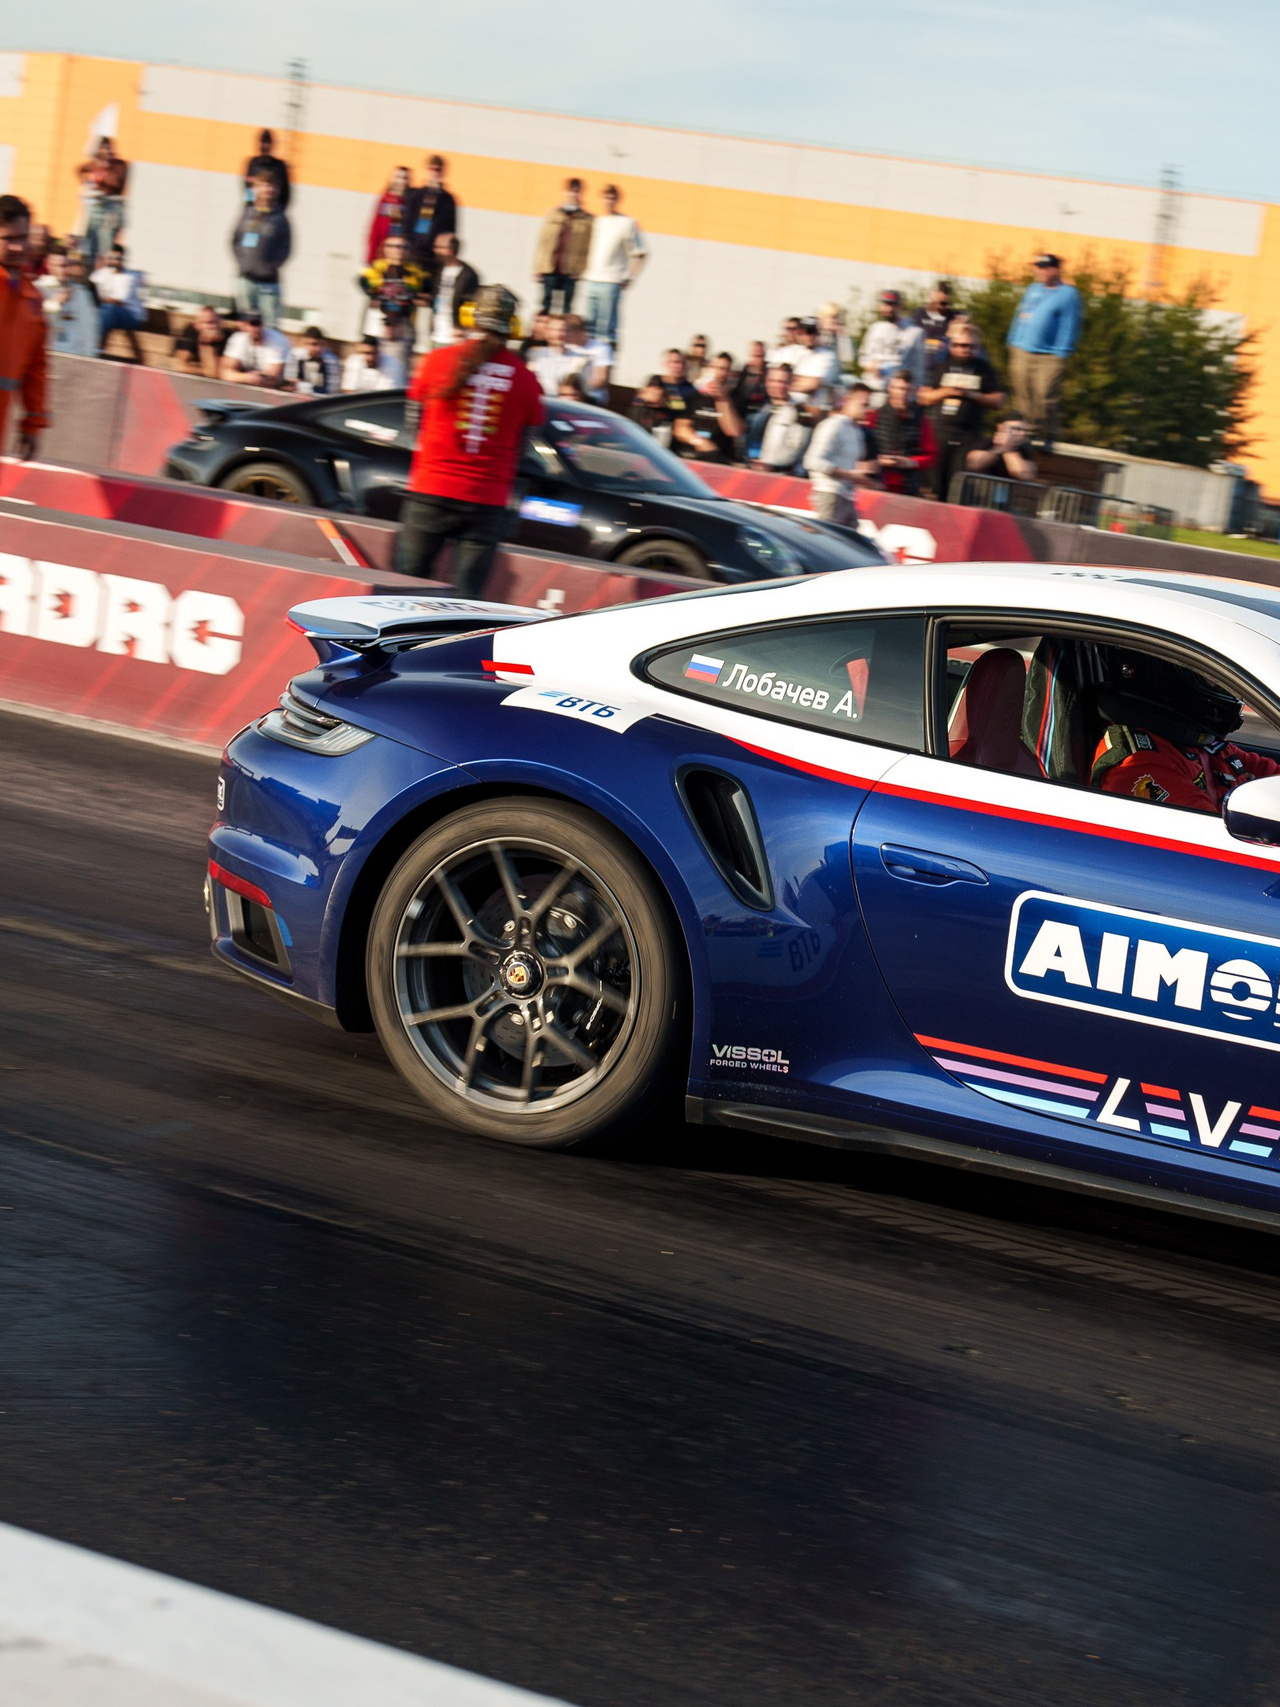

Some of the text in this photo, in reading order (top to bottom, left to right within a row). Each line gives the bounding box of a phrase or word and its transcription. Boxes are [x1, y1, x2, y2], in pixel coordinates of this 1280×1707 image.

[722, 663, 858, 719] Лобачев А.
[555, 696, 622, 718] ВТБ
[712, 1044, 790, 1065] VISSOL
[710, 1059, 789, 1074] FORGED WHEELS
